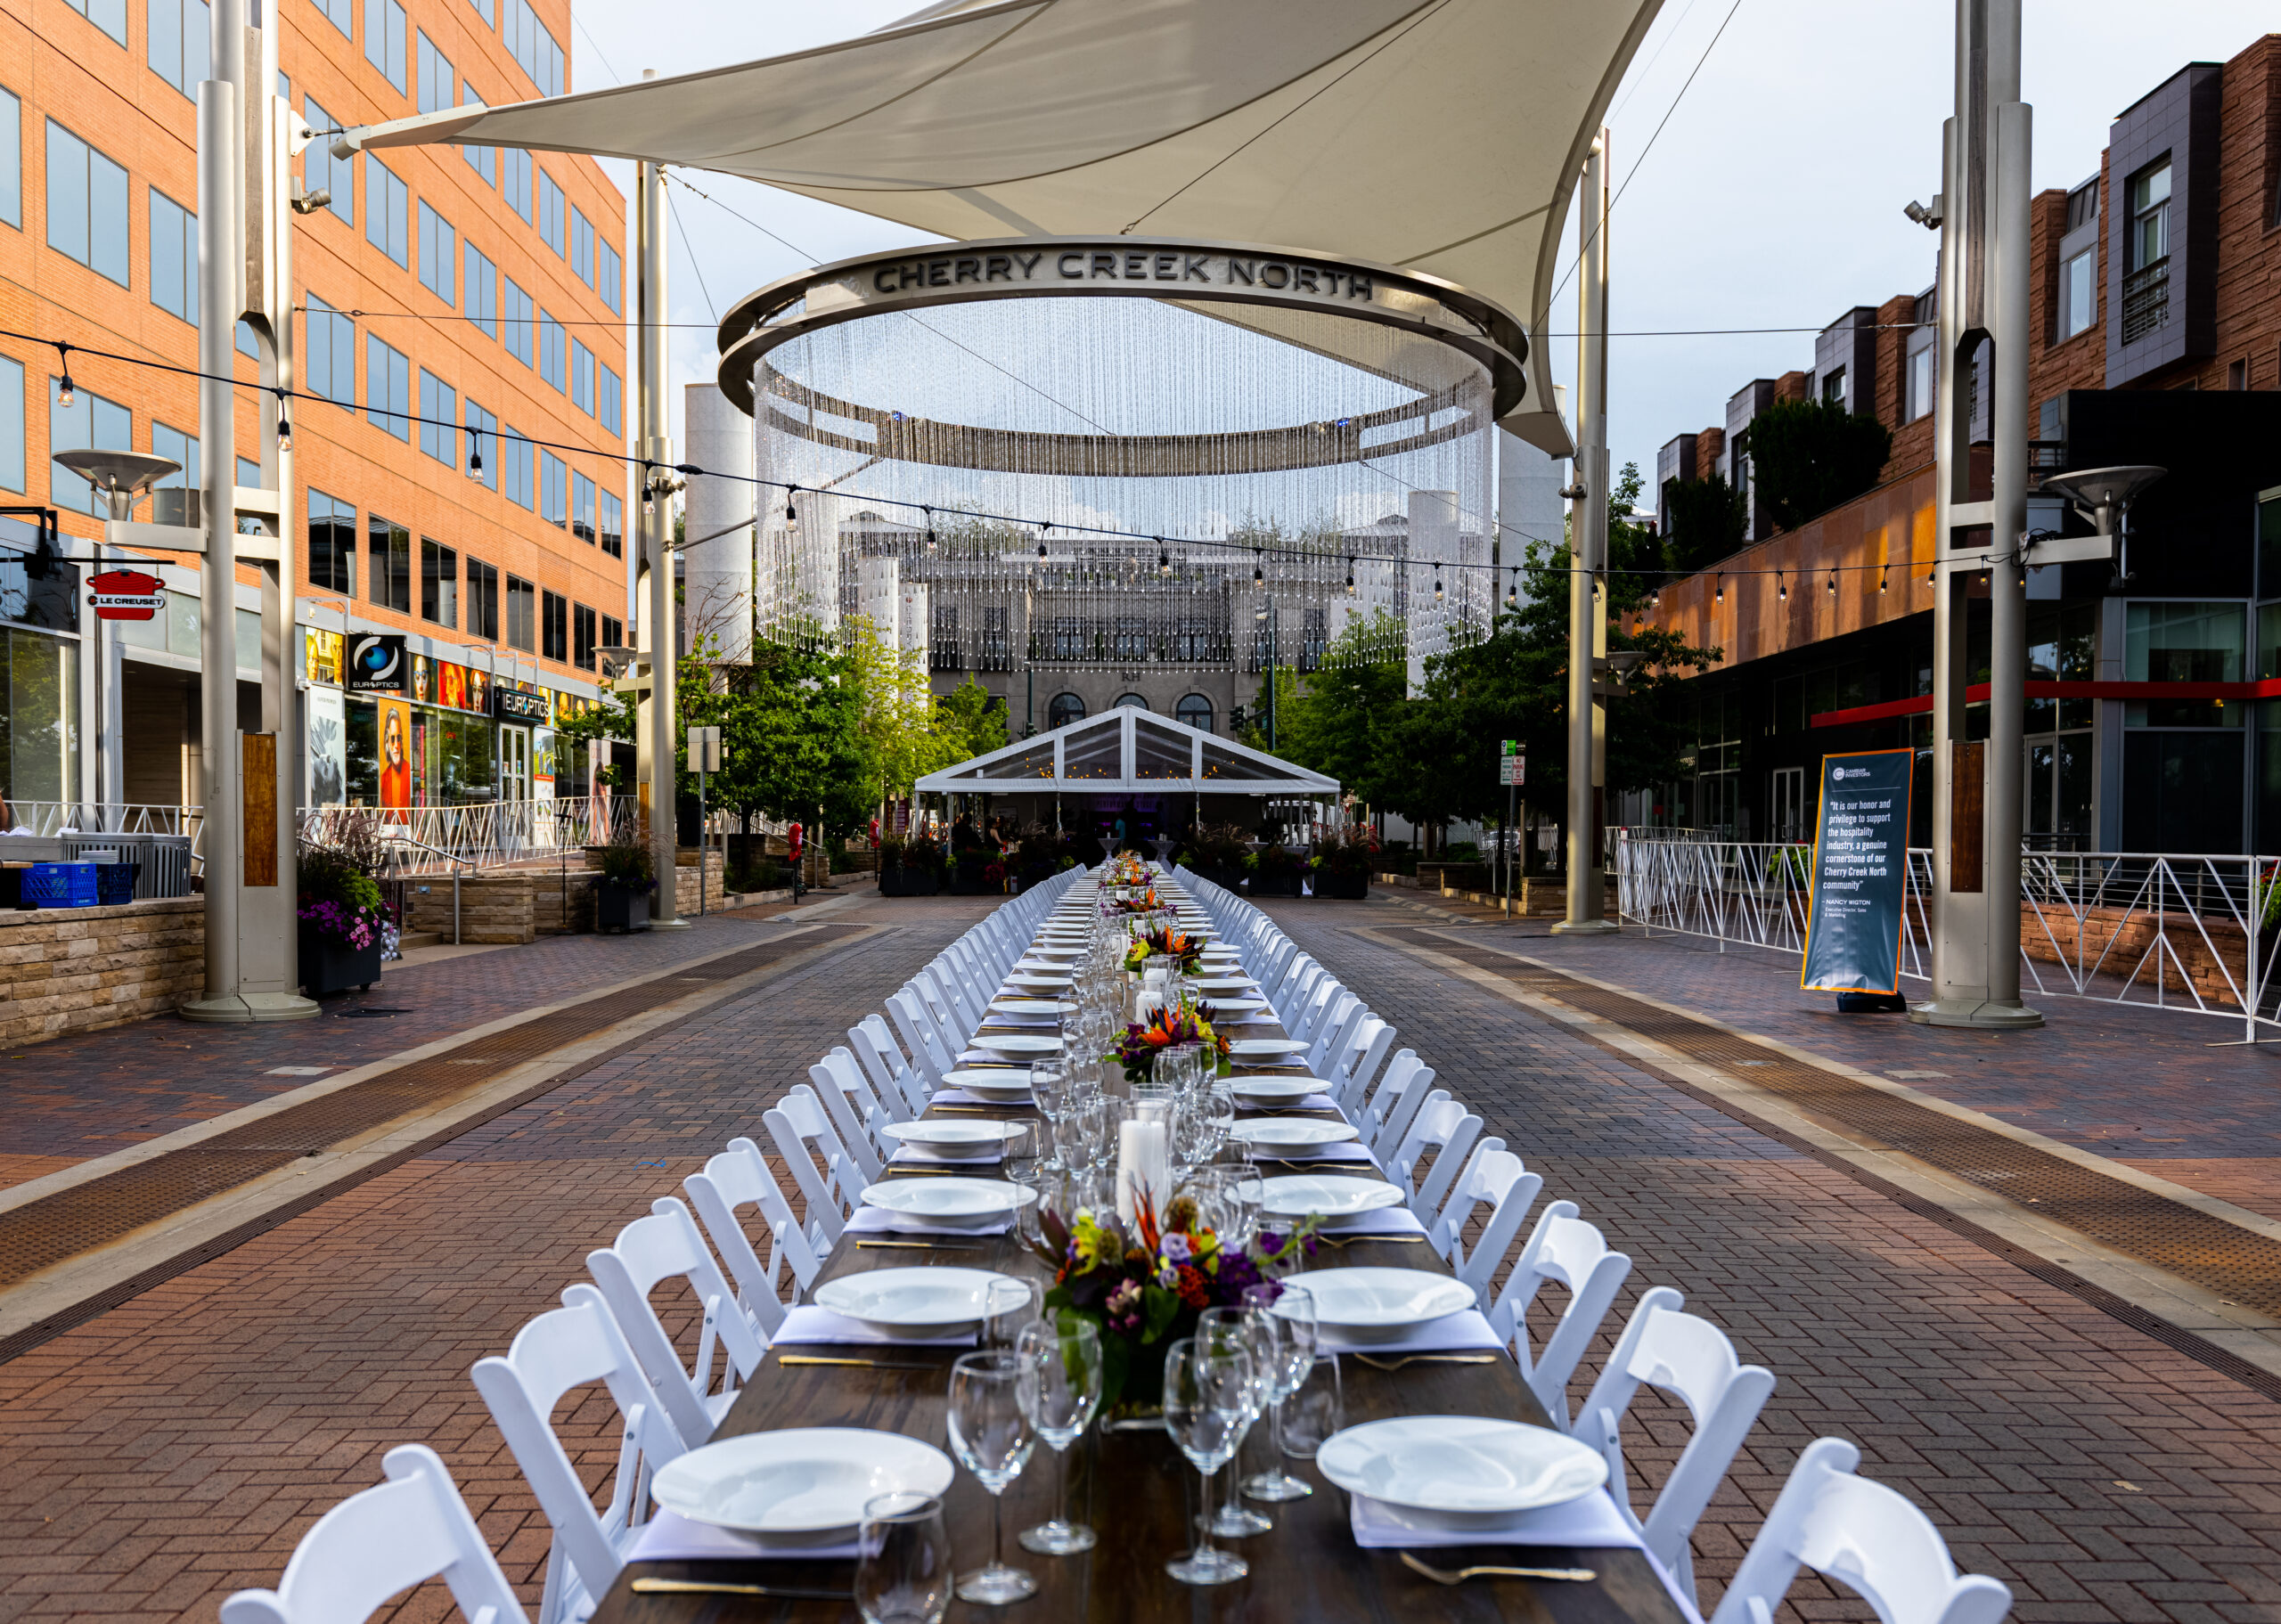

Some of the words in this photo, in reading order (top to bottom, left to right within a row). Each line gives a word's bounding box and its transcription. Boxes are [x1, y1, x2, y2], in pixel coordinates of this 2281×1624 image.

[873, 252, 1042, 293] CHERRY
[1058, 250, 1211, 281] CREEK
[1229, 257, 1373, 301] NORTH
[114, 598, 162, 606] CREUSET
[1122, 672, 1141, 682] RH
[353, 681, 400, 689] EUROPTICS
[505, 693, 550, 718] EUROPTICS
[1839, 801, 1845, 811] is
[1846, 803, 1859, 811] our
[1859, 800, 1878, 810] honor
[1878, 798, 1891, 809] and
[1828, 813, 1858, 825] privilege
[1859, 813, 1865, 823] to
[1866, 812, 1891, 824] support
[1827, 827, 1838, 837] the
[1840, 827, 1874, 838] hospitality
[1826, 840, 1854, 852] industry,
[1856, 842, 1860, 850] a
[1861, 840, 1887, 851] genuine
[1825, 853, 1865, 863] cornerstone
[1866, 853, 1874, 863] of
[1874, 854, 1886, 863] our
[1824, 866, 1847, 878] Cherry
[1848, 866, 1868, 877] Creek
[1868, 866, 1887, 877] North
